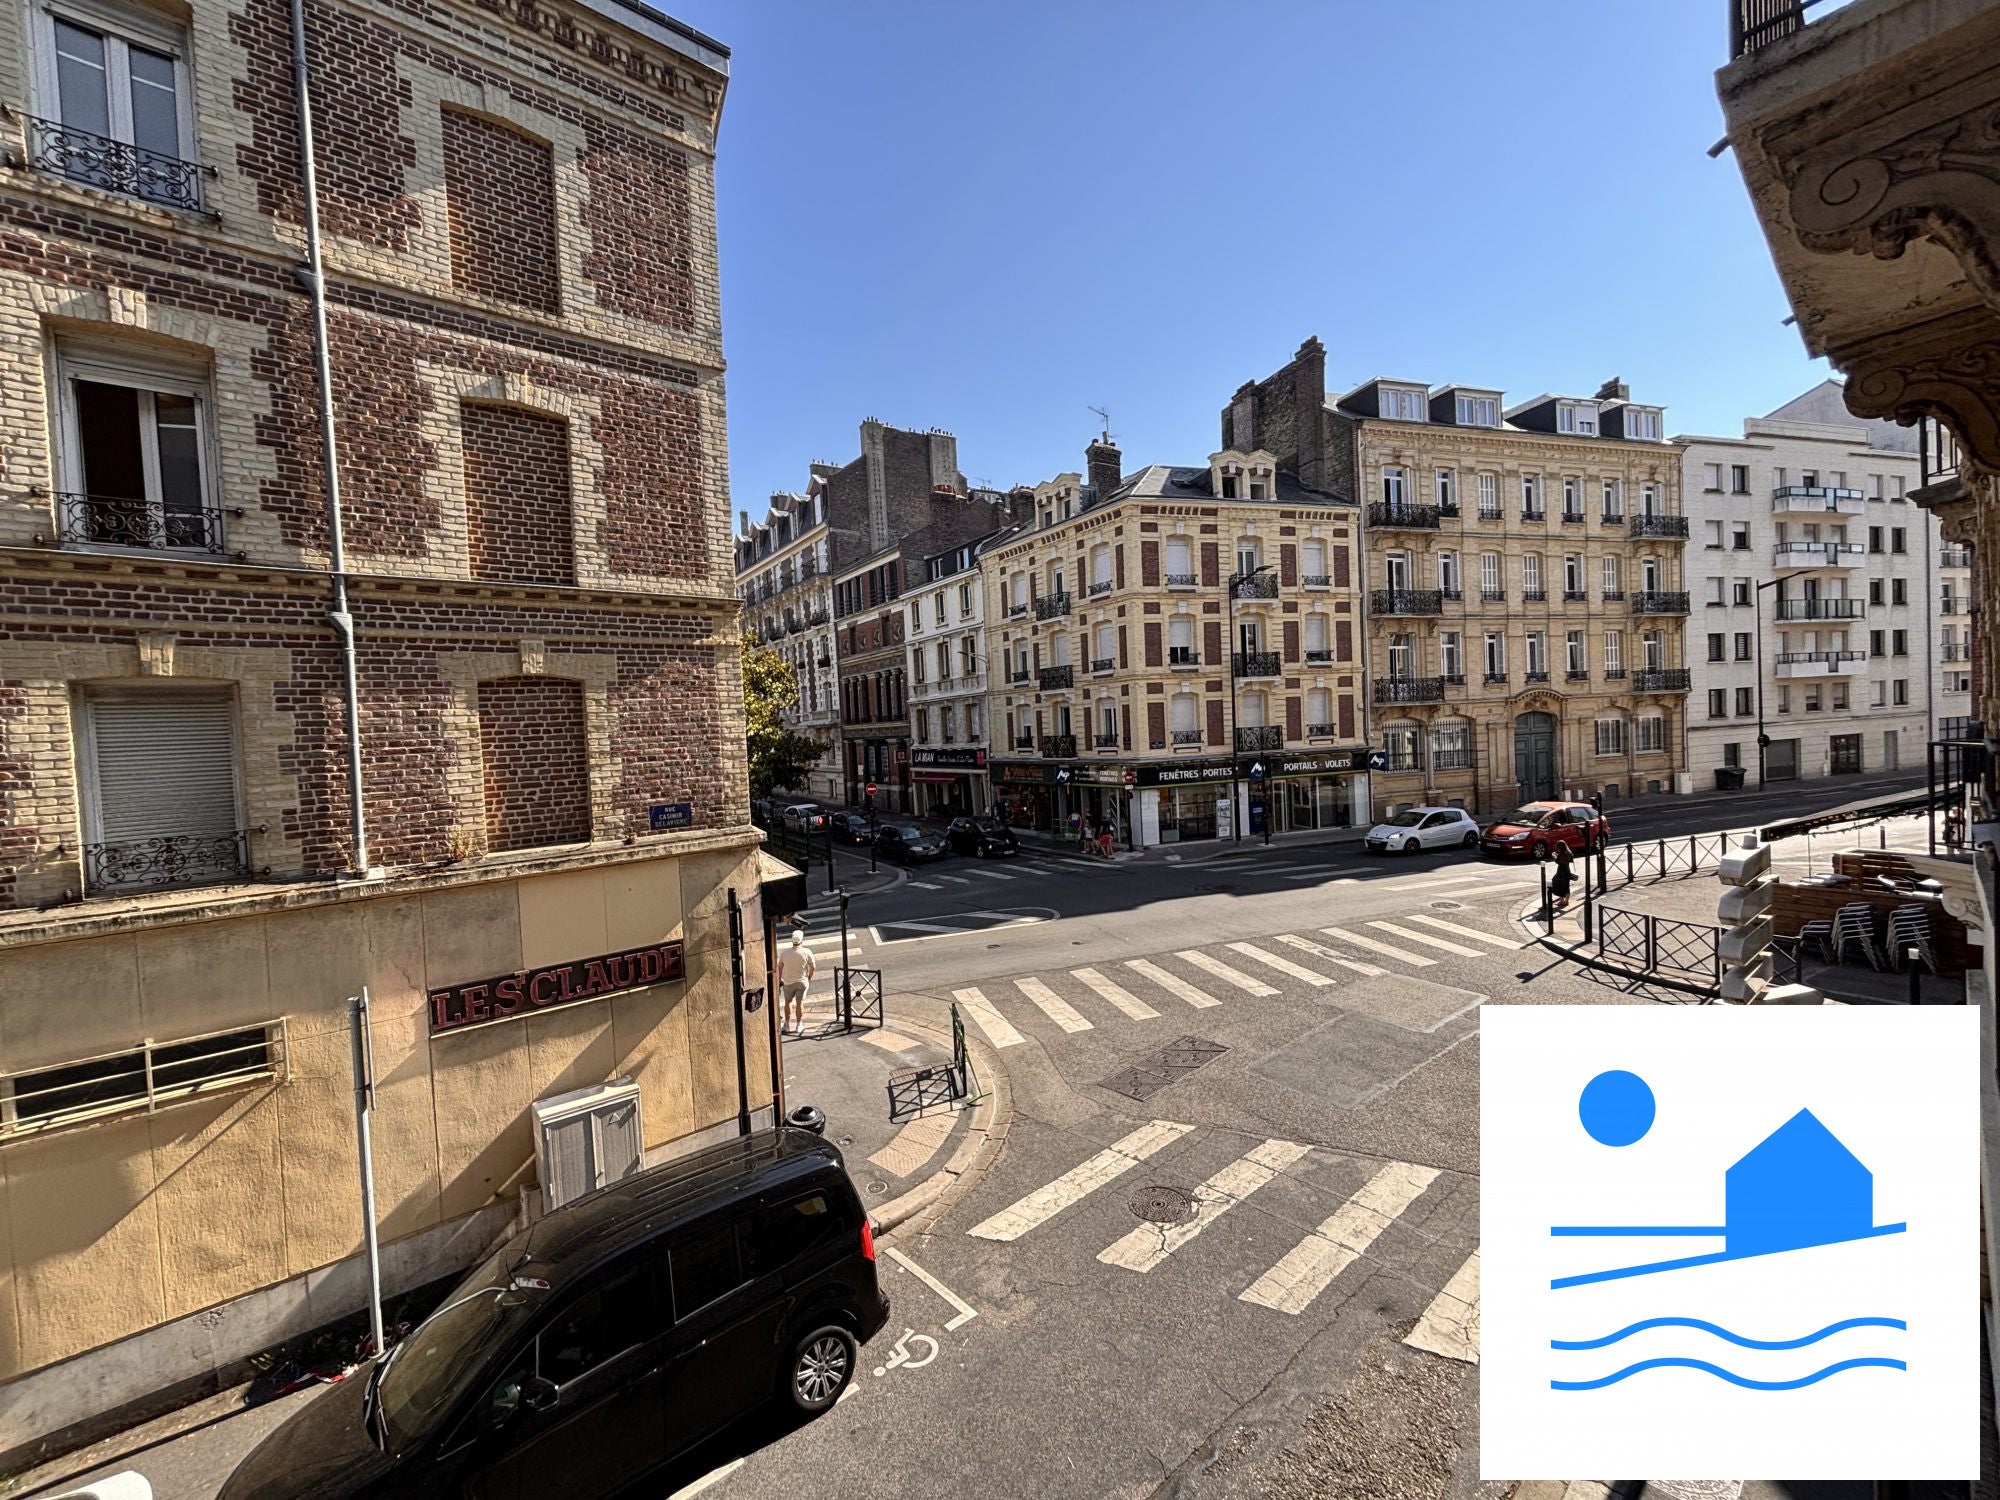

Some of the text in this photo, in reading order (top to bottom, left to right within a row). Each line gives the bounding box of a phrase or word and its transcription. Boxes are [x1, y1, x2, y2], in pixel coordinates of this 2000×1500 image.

[1283, 758, 1351, 772] PORTAILS VOLETS
[1158, 766, 1233, 781] FENÊTRES PORTES
[658, 812, 683, 821] CASIMIR
